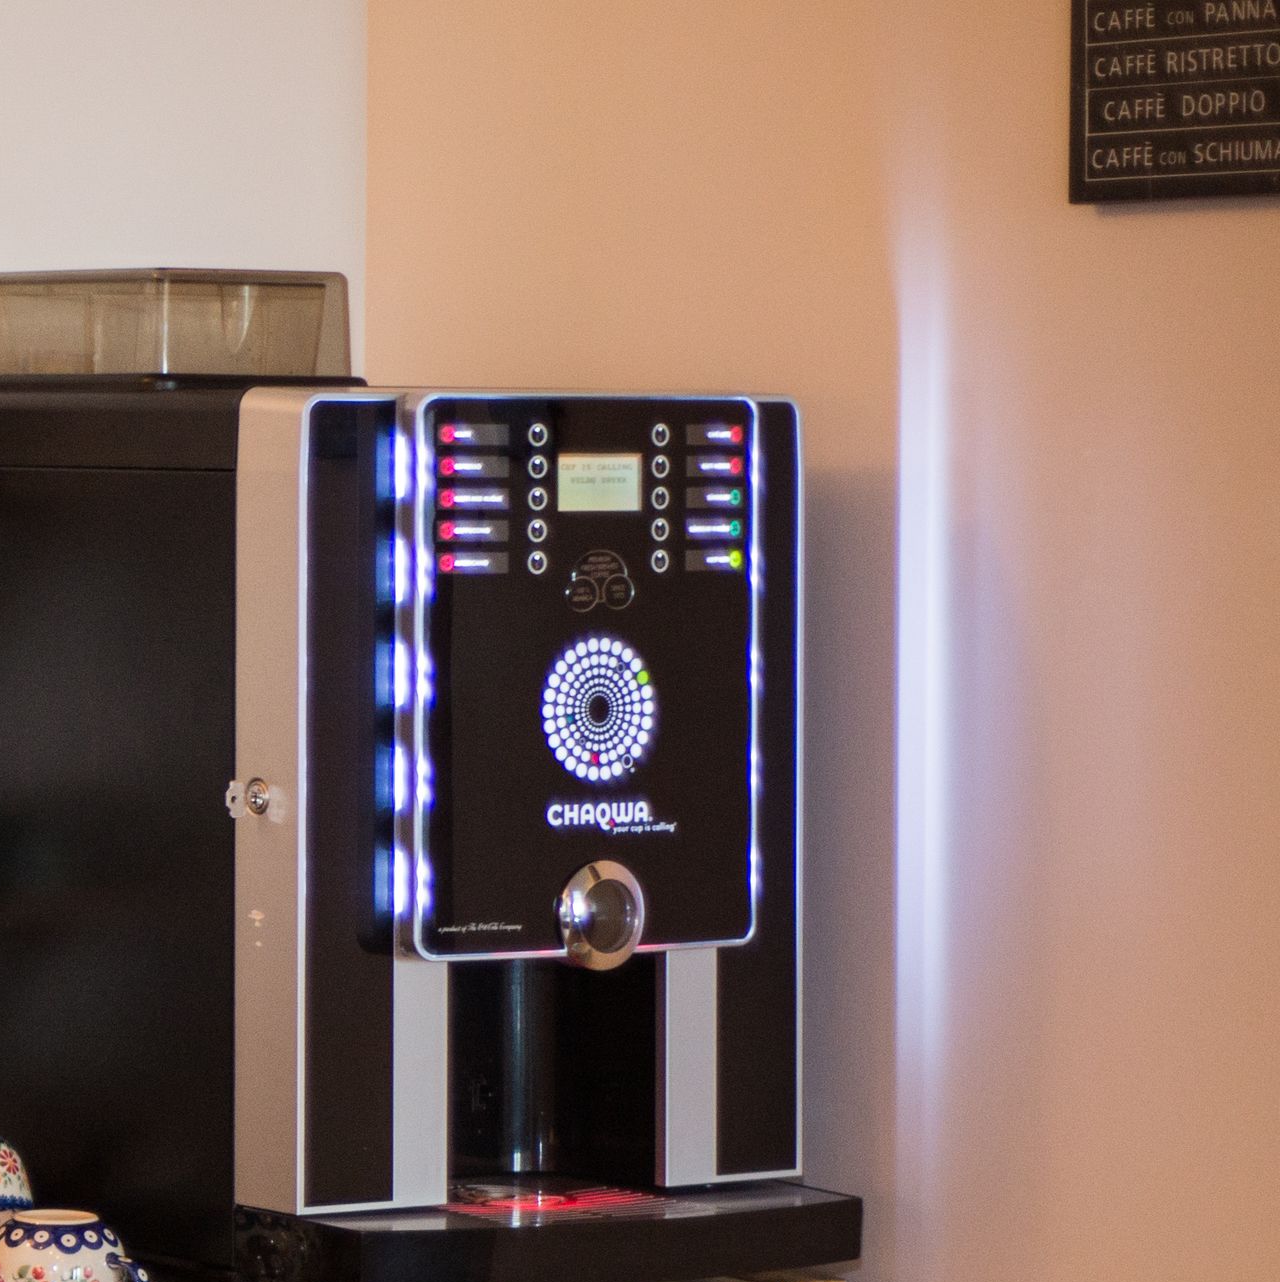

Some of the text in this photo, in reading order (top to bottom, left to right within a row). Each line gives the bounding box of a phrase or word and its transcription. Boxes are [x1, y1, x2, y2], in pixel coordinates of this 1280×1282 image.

[1093, 0, 1277, 32] CAFFÈ CON PANNA
[1094, 42, 1280, 78] CAFFÈ RISTRETTO
[1103, 89, 1266, 121] CAFFÈ DOPPIO
[1091, 141, 1153, 169] CAFFÈ
[1158, 150, 1187, 165] CON
